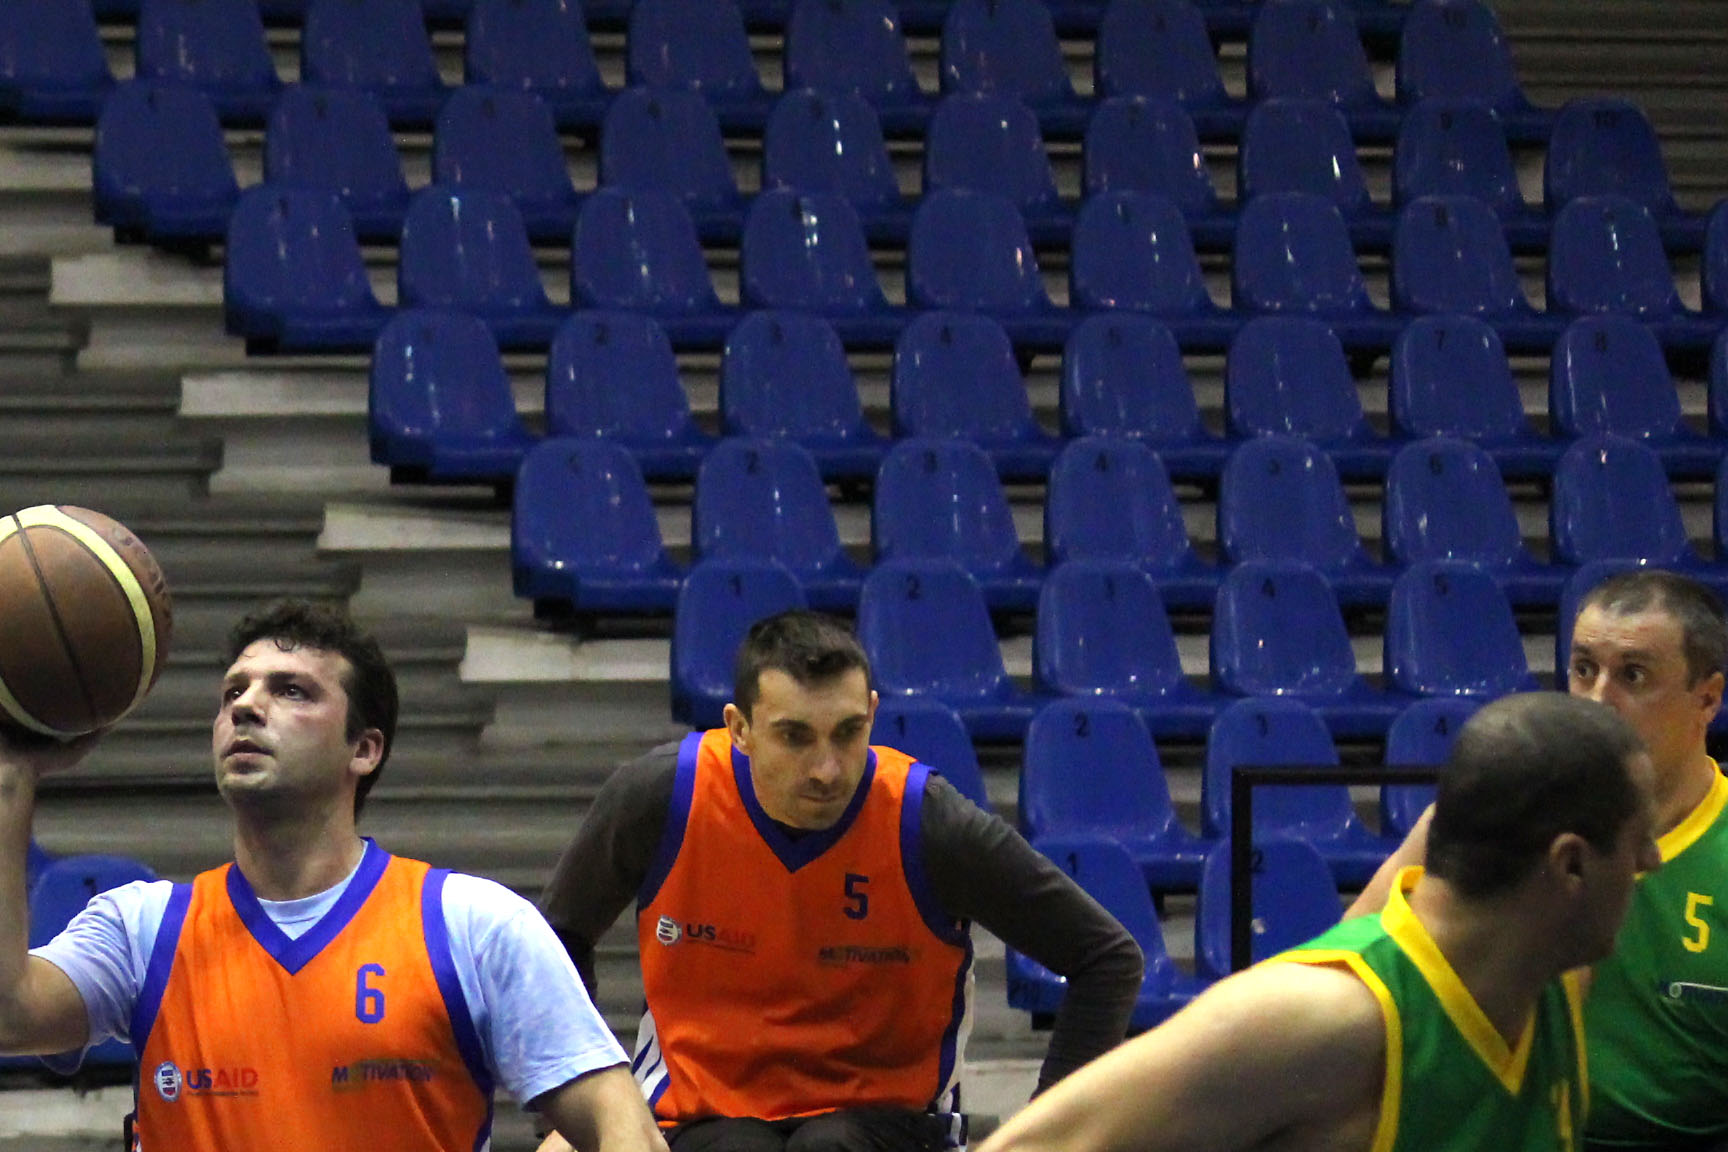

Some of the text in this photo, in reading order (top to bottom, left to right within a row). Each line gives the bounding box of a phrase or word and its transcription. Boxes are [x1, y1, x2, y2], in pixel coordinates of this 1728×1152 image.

[904, 573, 922, 600] 2
[893, 713, 908, 740] 1
[1073, 712, 1091, 739] 2
[1433, 714, 1449, 738] 4
[1065, 851, 1078, 877] 1
[843, 873, 870, 920] 5
[1681, 892, 1714, 953] 5
[355, 963, 386, 1025] 6
[185, 1066, 259, 1090] USAID
